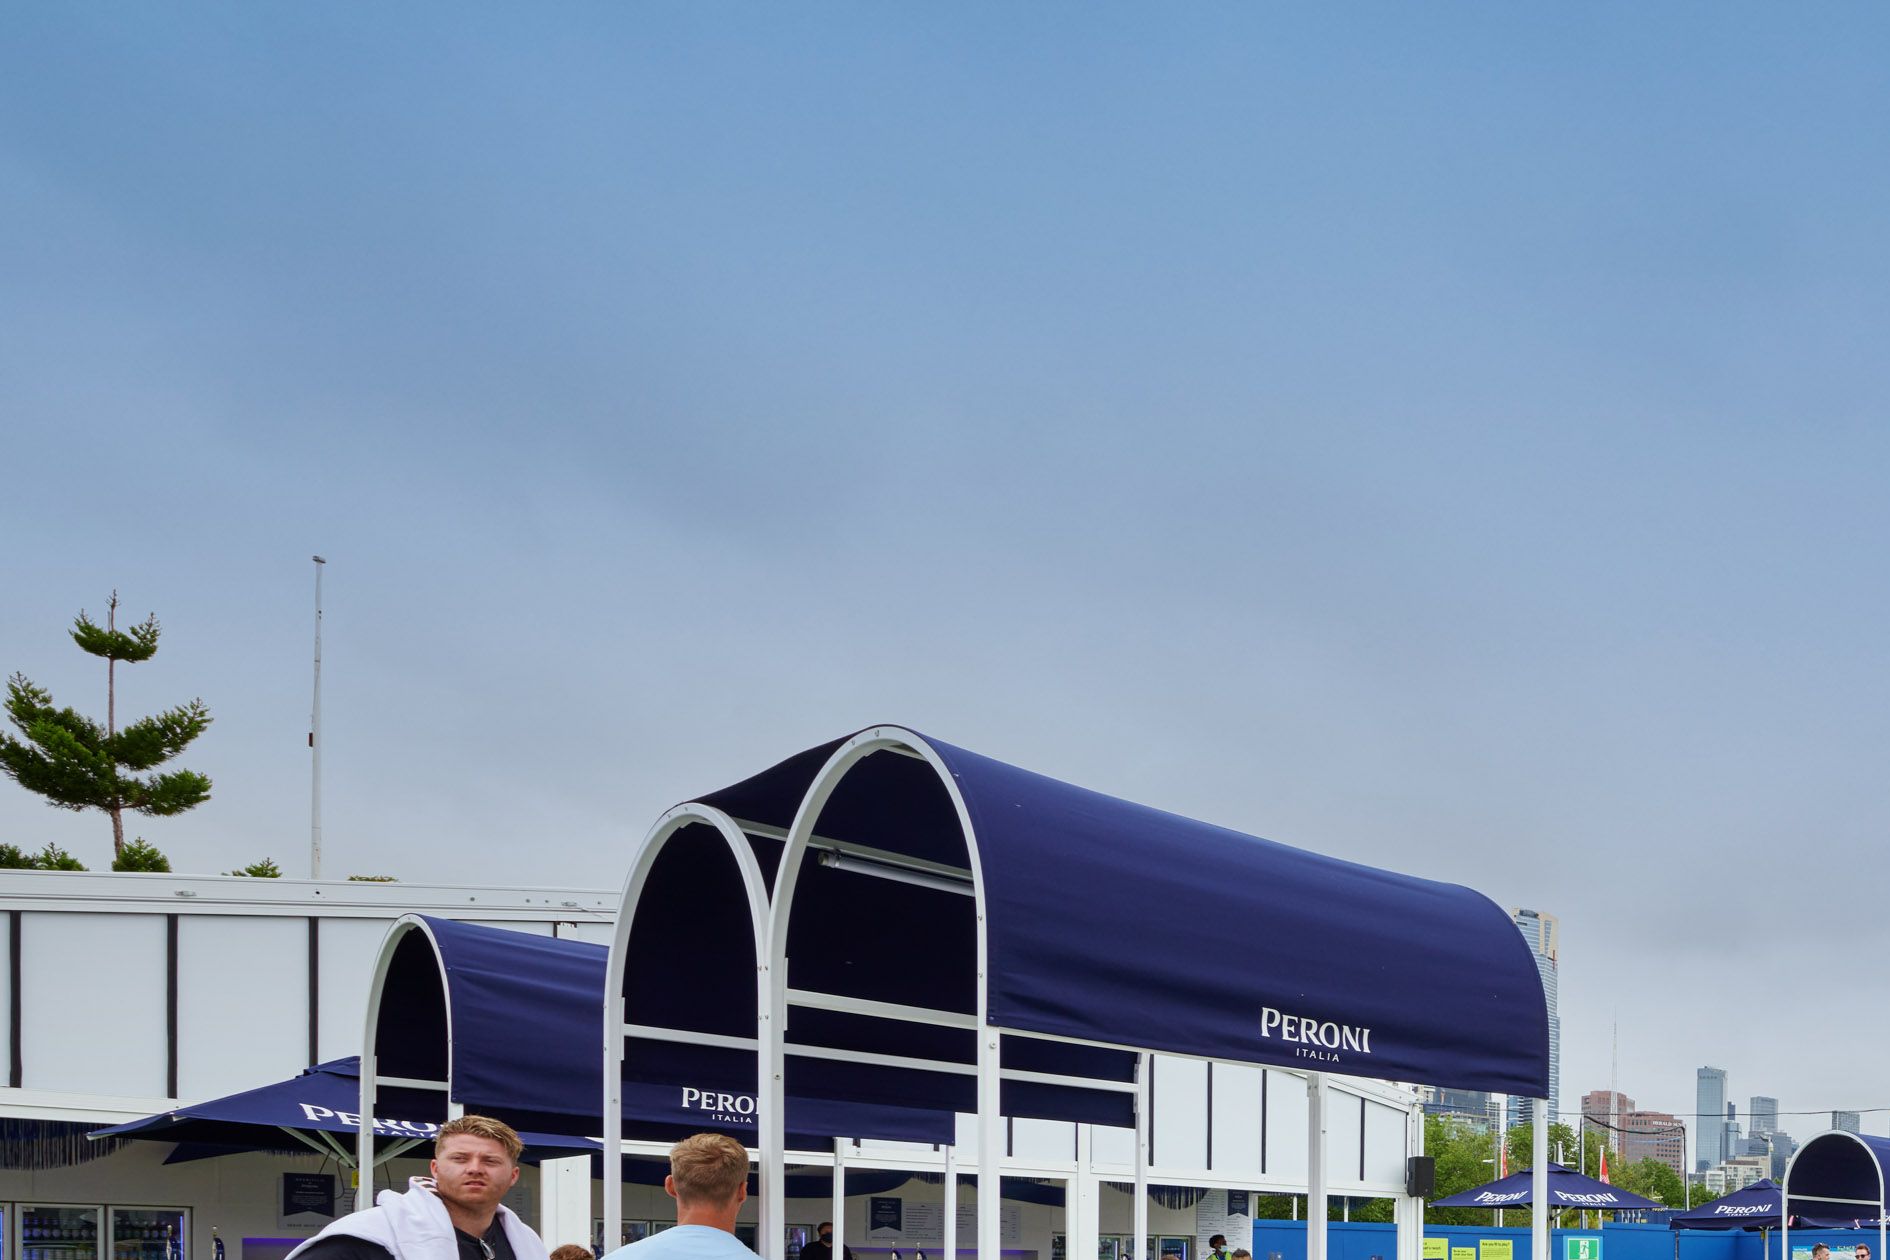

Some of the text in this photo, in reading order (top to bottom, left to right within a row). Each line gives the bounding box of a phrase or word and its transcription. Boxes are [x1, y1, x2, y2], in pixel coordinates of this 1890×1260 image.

[1261, 1007, 1371, 1053] PERONI
[1296, 1048, 1340, 1062] ITALIA
[712, 1113, 753, 1124] ITALIA
[1474, 1190, 1528, 1202] PERONI
[1554, 1190, 1619, 1203] PERONI
[1715, 1204, 1772, 1214] PERONI
